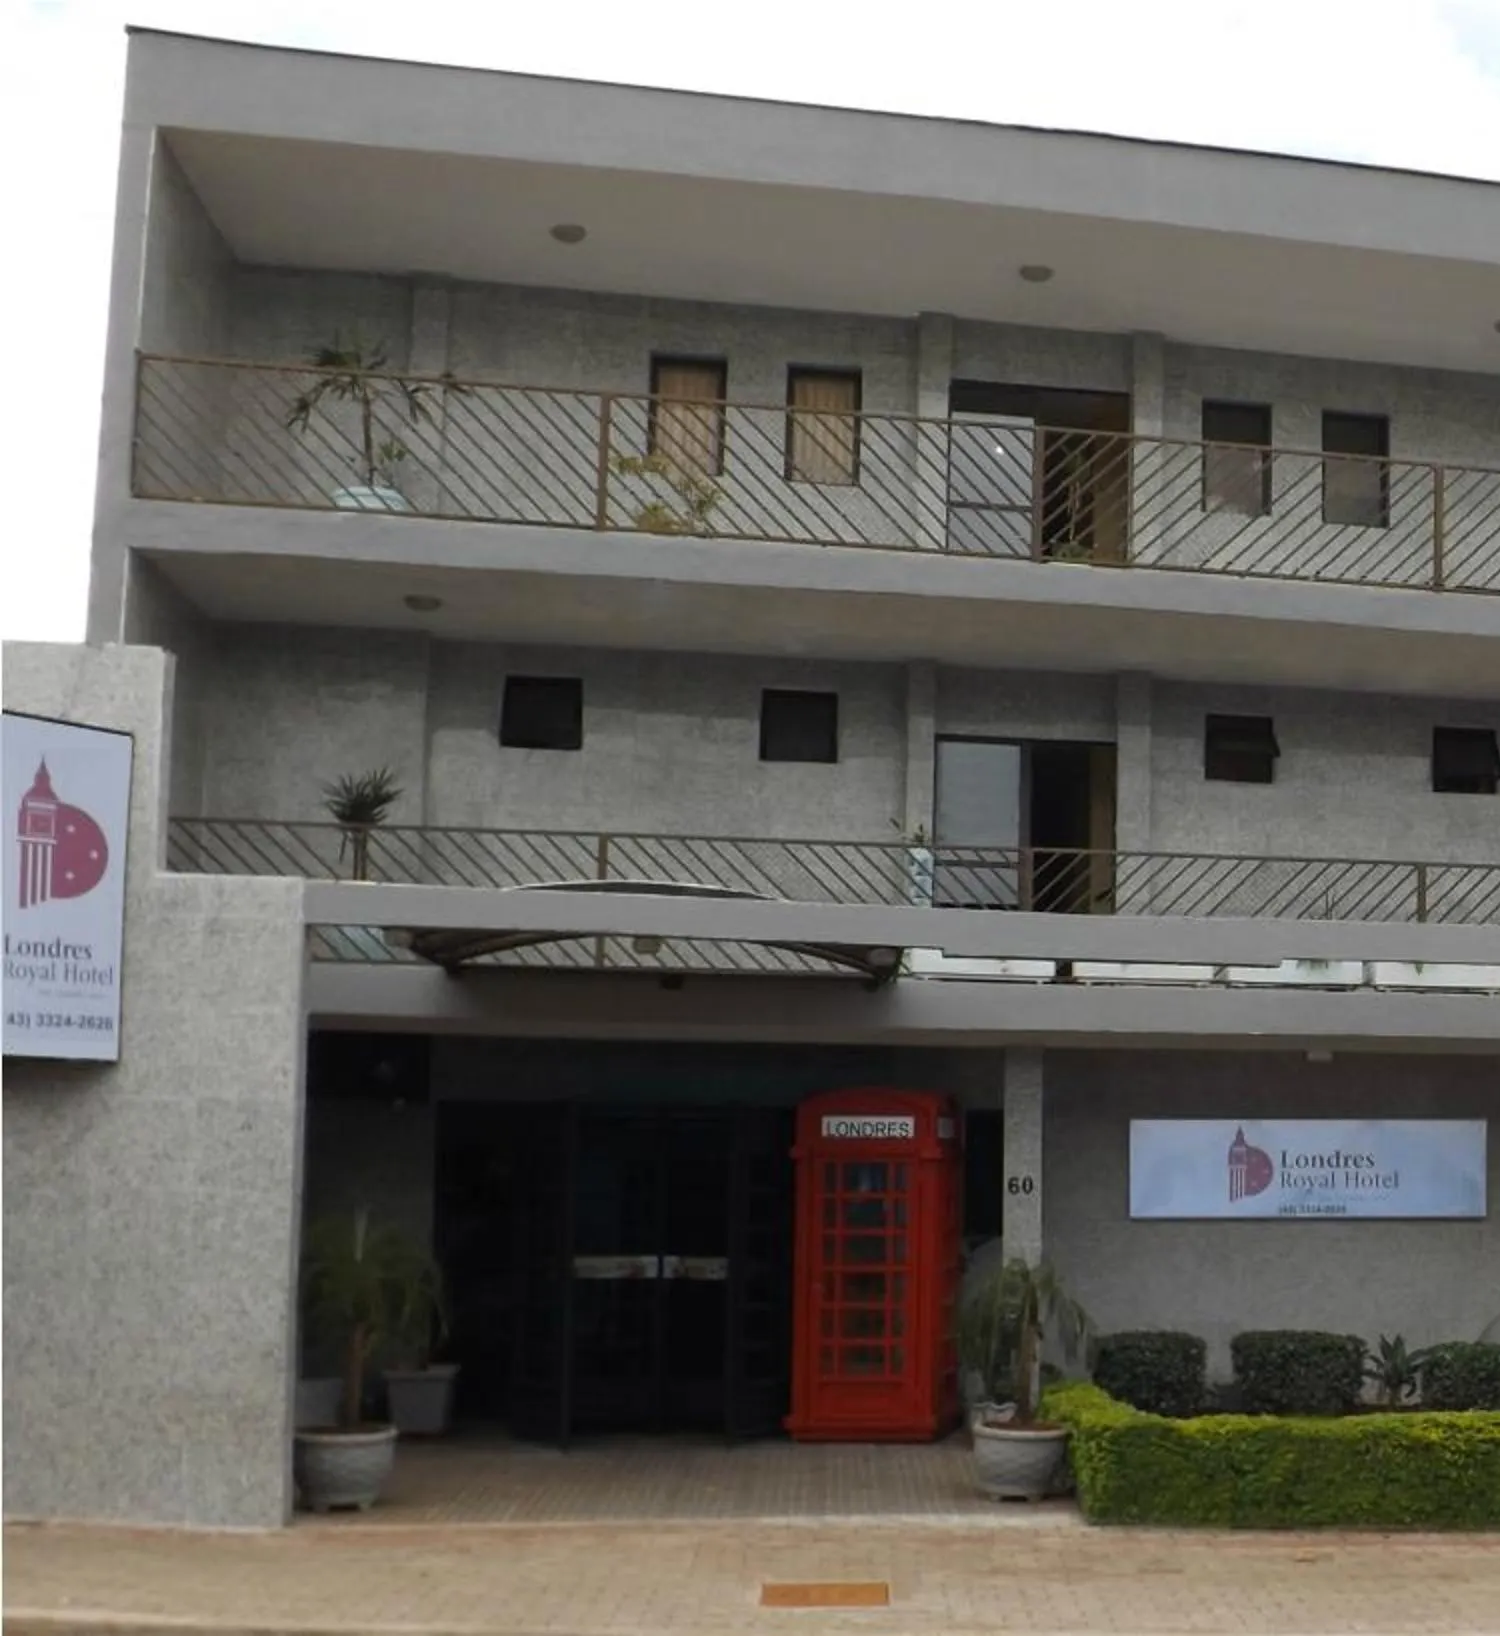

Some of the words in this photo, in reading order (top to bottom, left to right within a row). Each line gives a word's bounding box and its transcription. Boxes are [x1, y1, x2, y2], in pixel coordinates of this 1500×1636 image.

[5, 934, 93, 960] Londres
[4, 960, 57, 987] Royal
[63, 962, 114, 986] Hotel
[827, 1120, 909, 1137] LONDRES
[1280, 1150, 1376, 1169] Londres
[1007, 1176, 1034, 1195] 60
[1280, 1171, 1336, 1195] Royal
[1345, 1170, 1400, 1189] Hotel
